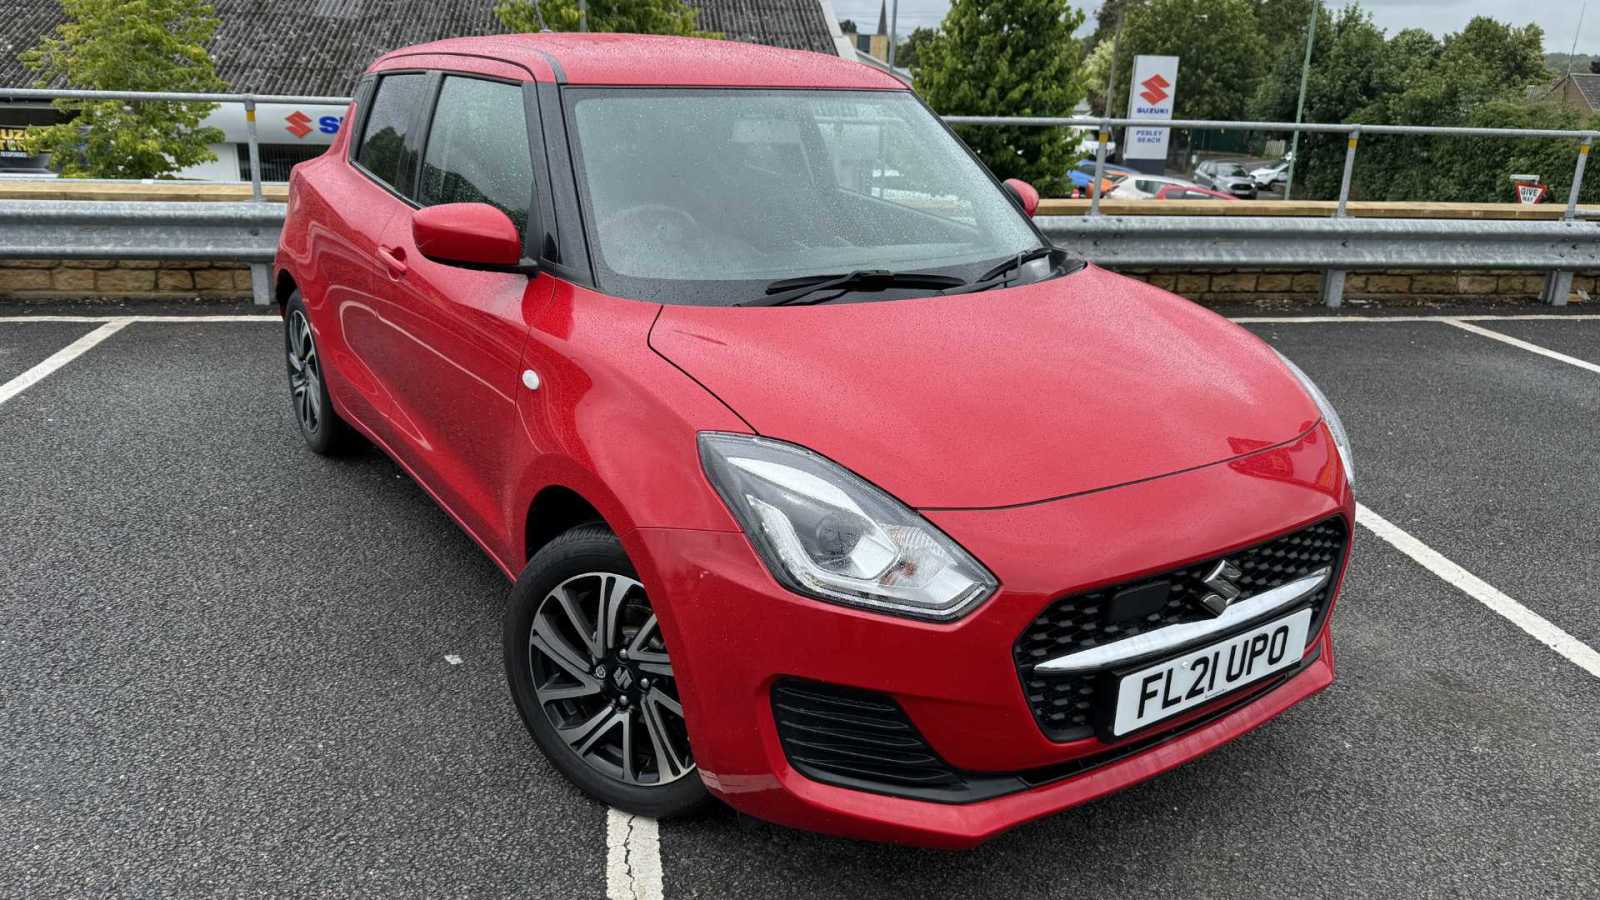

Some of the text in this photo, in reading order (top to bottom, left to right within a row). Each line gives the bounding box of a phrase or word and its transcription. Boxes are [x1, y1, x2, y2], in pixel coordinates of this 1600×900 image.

[319, 115, 343, 134] S
[1520, 188, 1538, 196] GIVE
[1137, 625, 1289, 720] FL21 UPO
